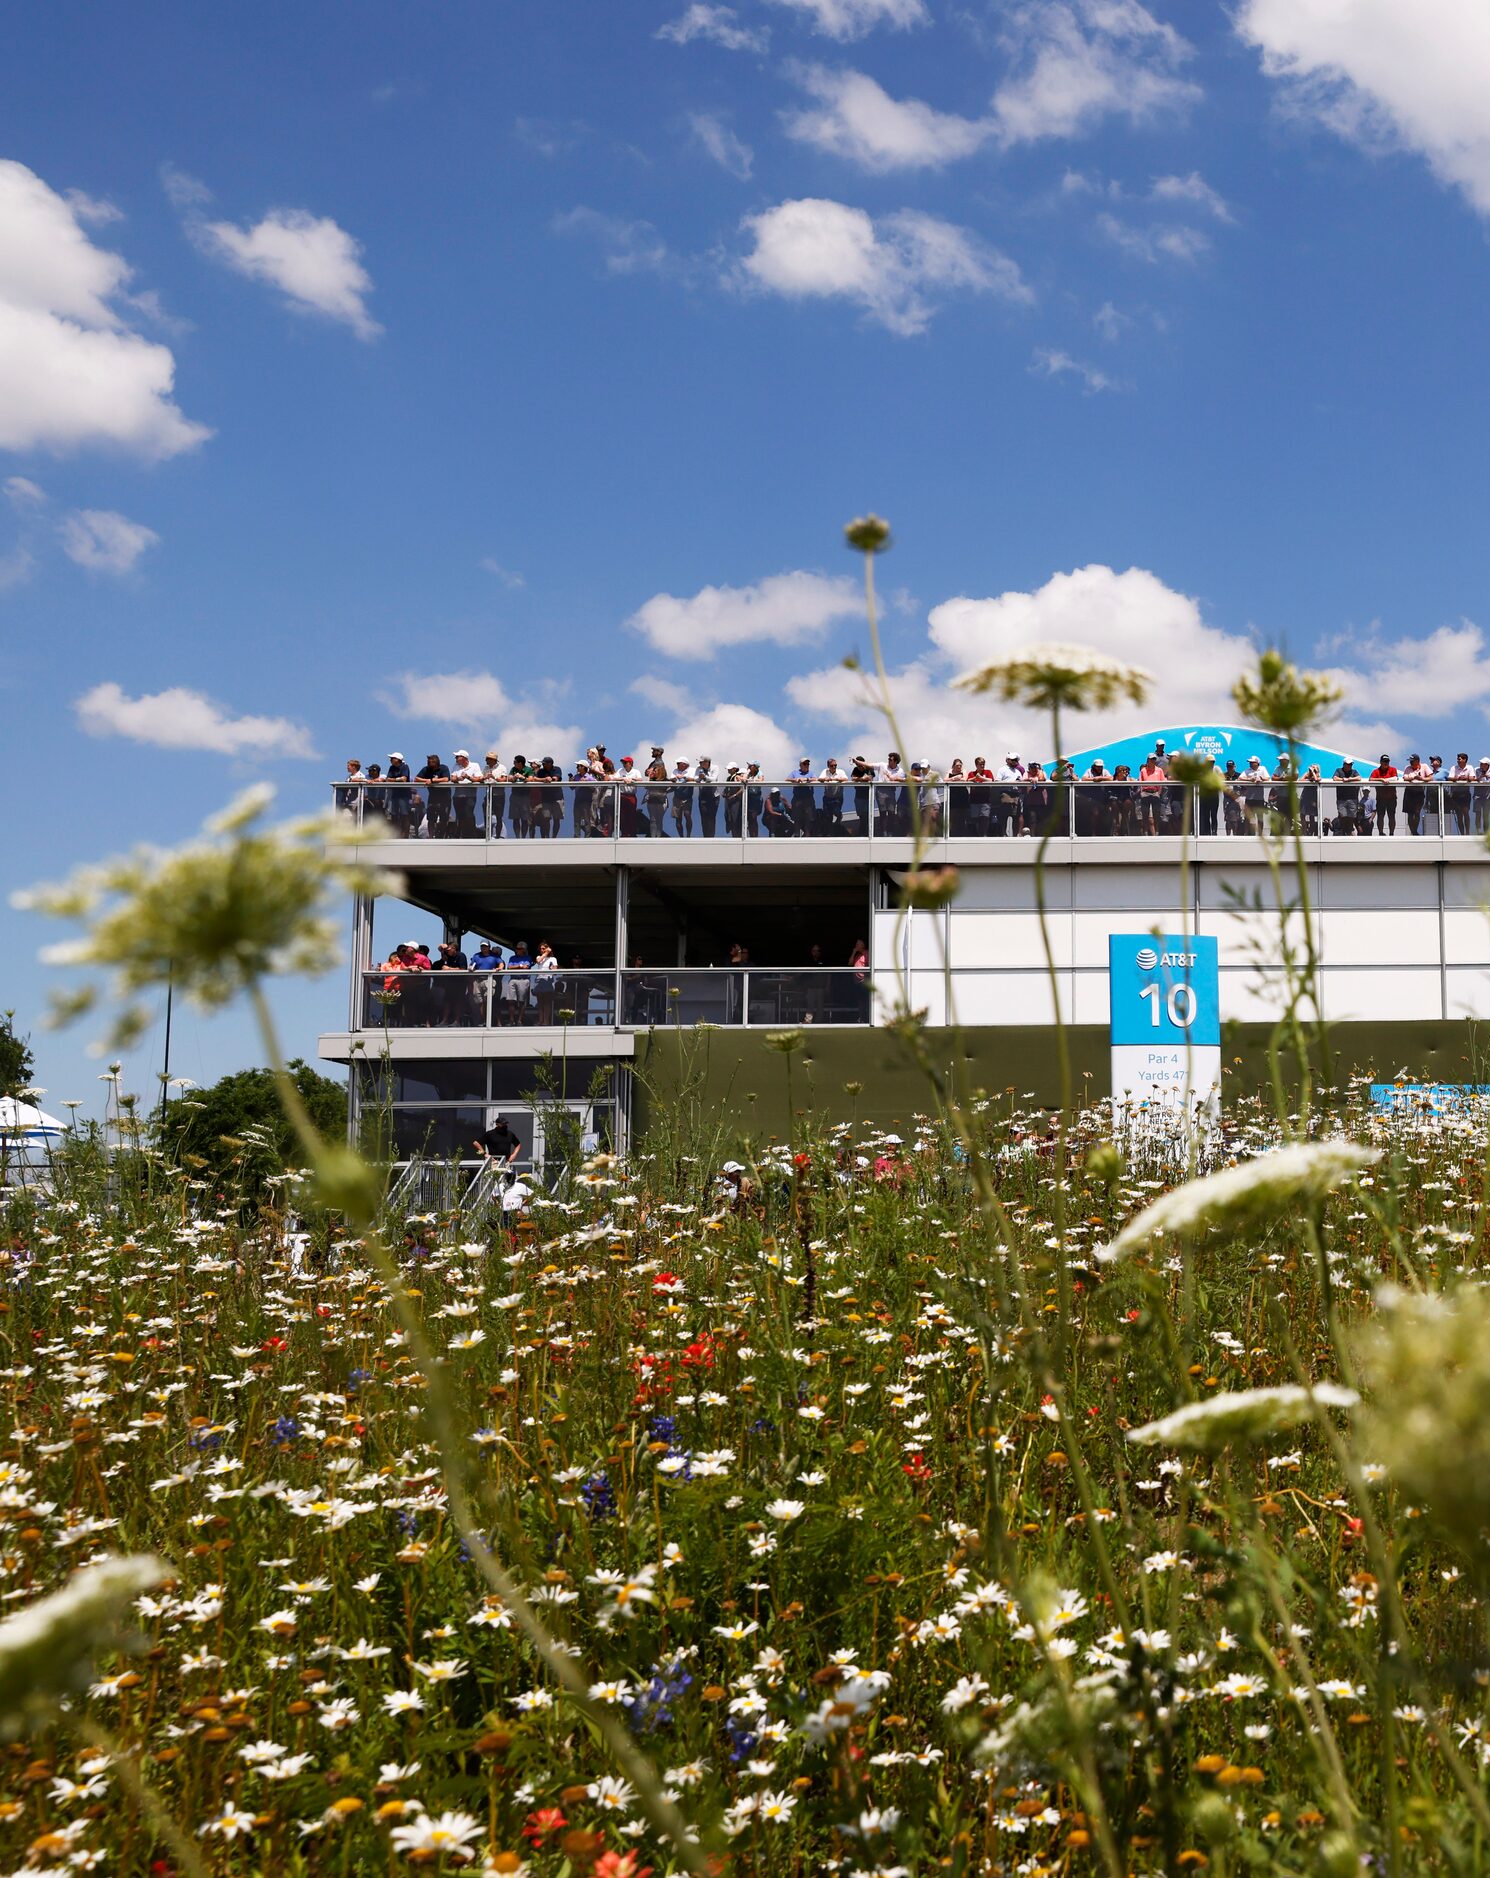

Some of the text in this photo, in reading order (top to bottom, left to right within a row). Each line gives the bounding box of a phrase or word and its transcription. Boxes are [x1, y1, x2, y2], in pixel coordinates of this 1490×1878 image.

[1159, 953, 1198, 968] AT&T
[1138, 983, 1197, 1028] 10
[1148, 1053, 1178, 1064] Par 4
[1138, 1070, 1170, 1081] Yards
